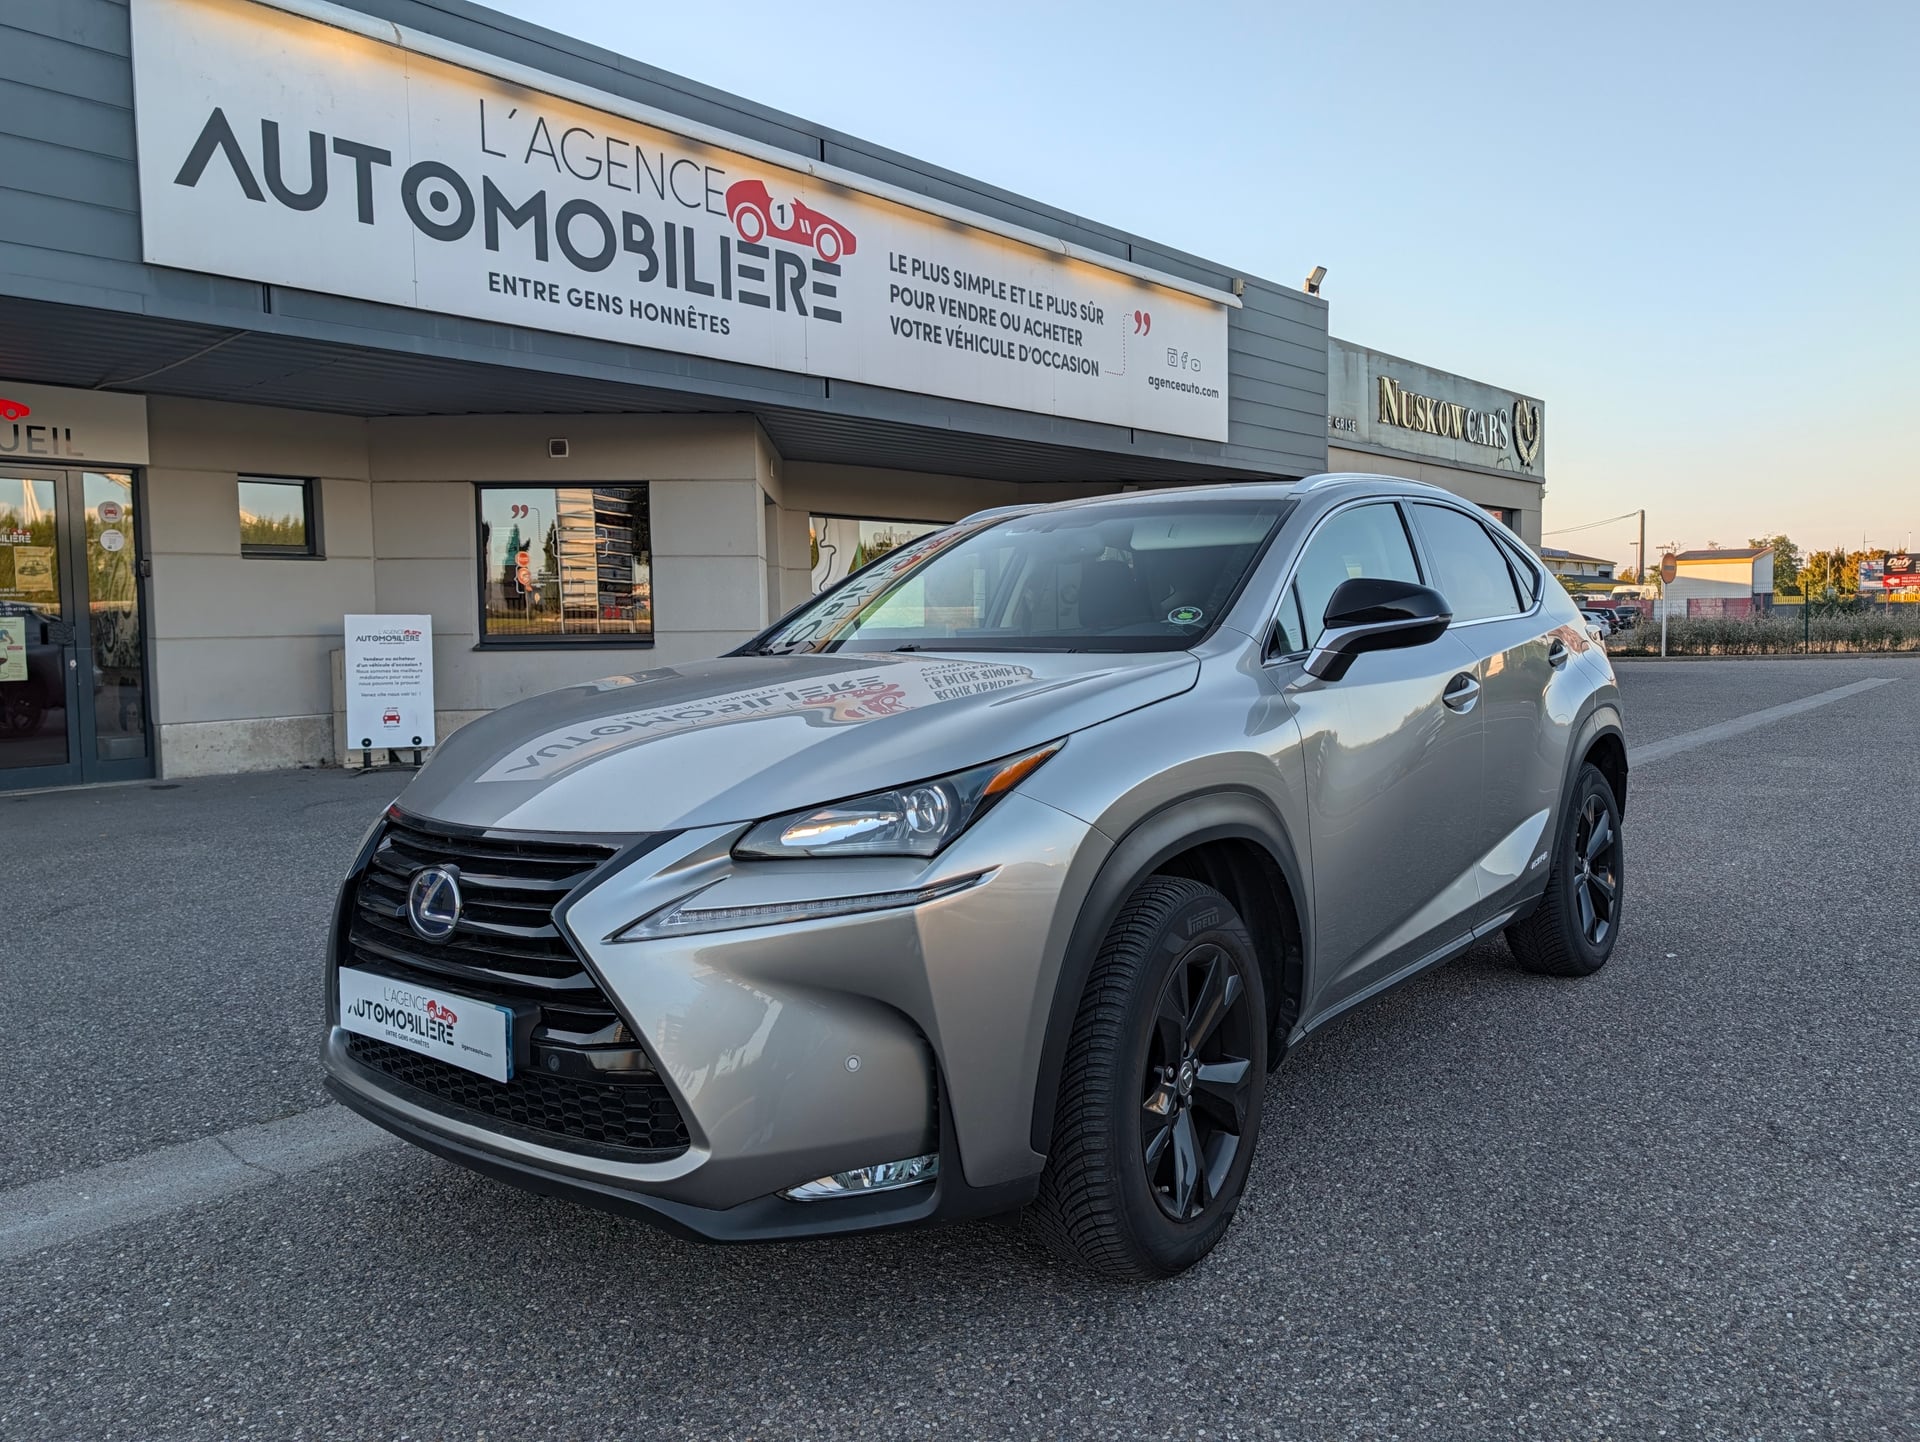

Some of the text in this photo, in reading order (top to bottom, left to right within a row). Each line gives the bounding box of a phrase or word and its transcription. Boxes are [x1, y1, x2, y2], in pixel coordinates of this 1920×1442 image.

[479, 98, 728, 218] L'AGENCE
[777, 204, 785, 224] 1
[889, 252, 1104, 325] LE PLUS SIMPLE ET LE PLUS SÛR
[488, 271, 730, 335] ENTRE GENS HONNÊTES
[889, 283, 1083, 347] POUR VENDRE OU ACHETER
[889, 315, 1099, 377] VOTRE VÉHICULE D'OCCASION
[1147, 374, 1219, 399] agenceauto.com
[1334, 417, 1356, 432] GRISE
[1887, 557, 1912, 569] Dafy
[384, 986, 428, 1013] L'AGENCE
[385, 1029, 398, 1039] ENTRE
[398, 1033, 408, 1042] GENS
[461, 1043, 493, 1058] agenceauto.com
